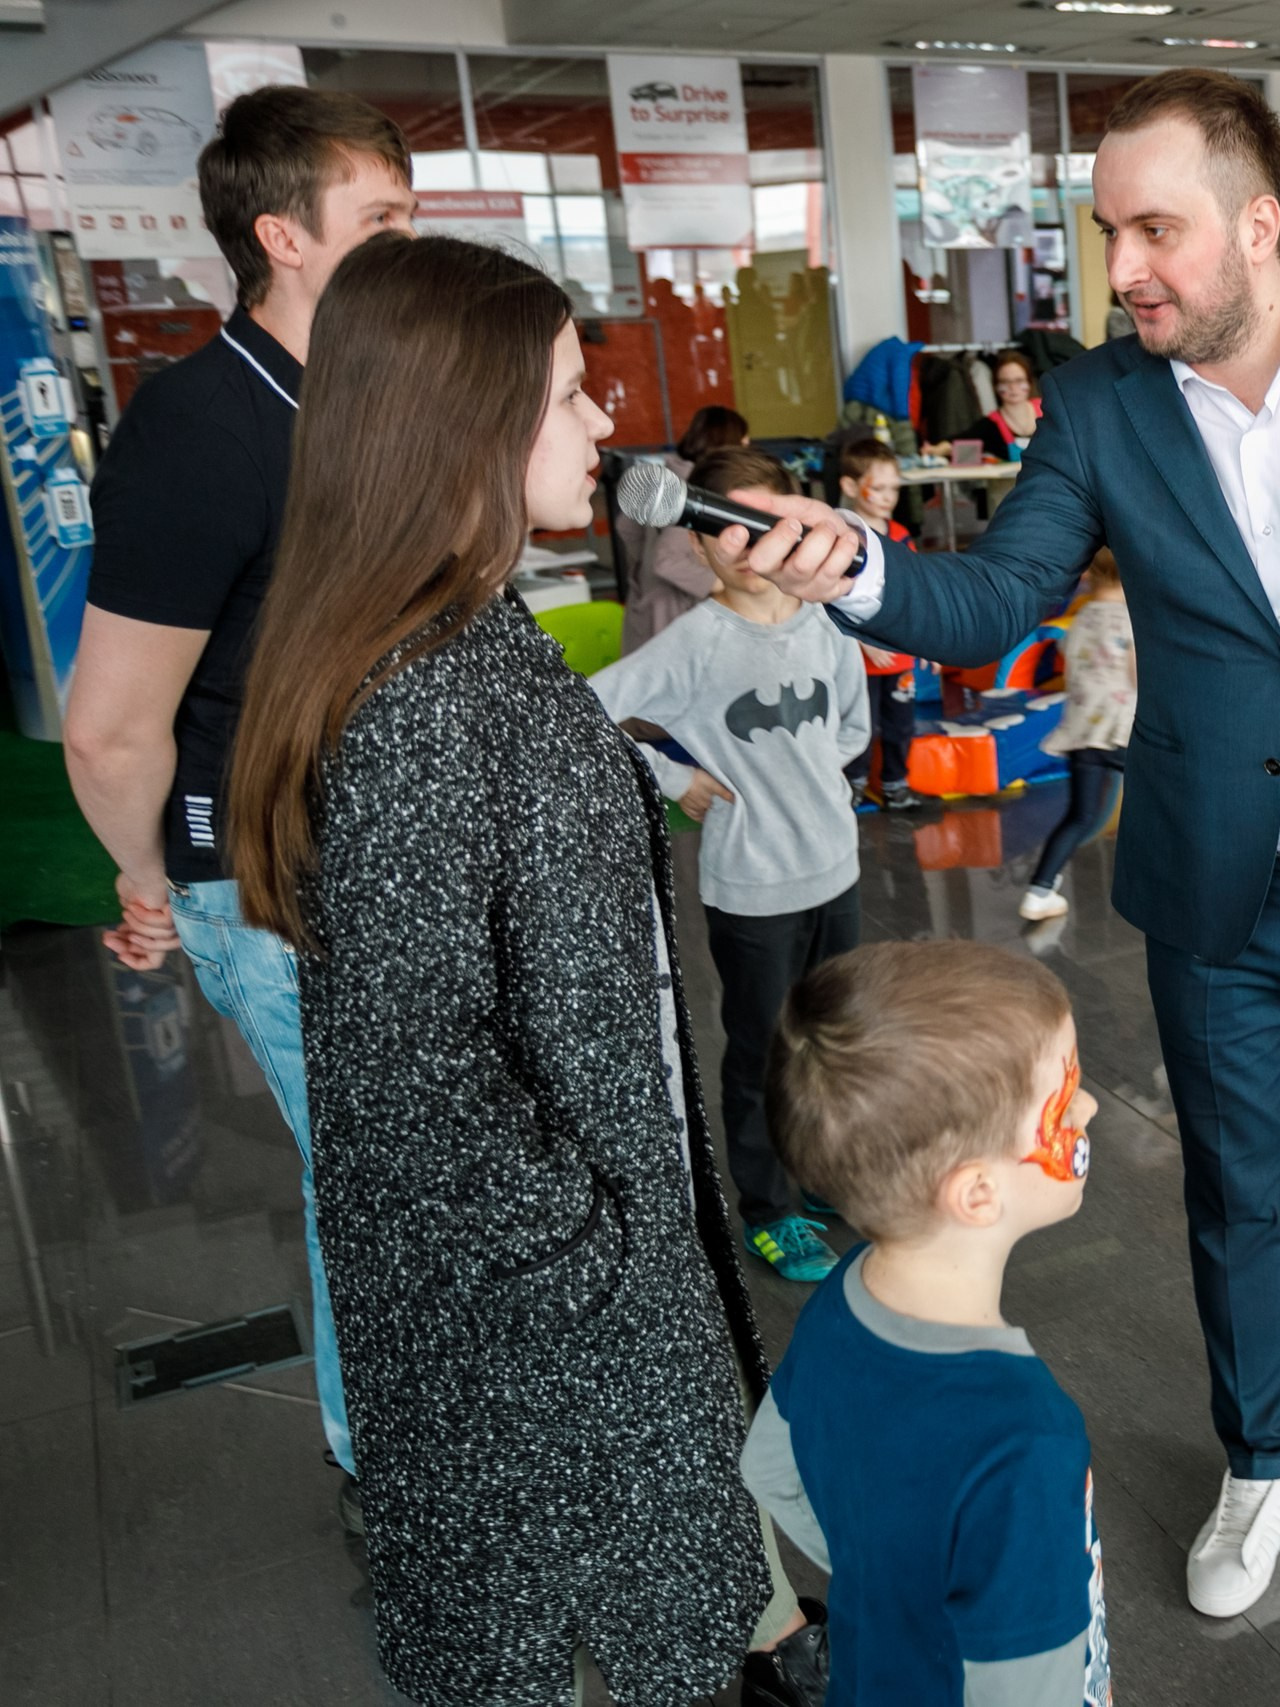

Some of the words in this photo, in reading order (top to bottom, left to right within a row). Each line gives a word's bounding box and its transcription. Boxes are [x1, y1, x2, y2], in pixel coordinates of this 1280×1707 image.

[681, 85, 729, 104] Drive
[630, 106, 650, 122] to
[656, 106, 731, 125] Surprise
